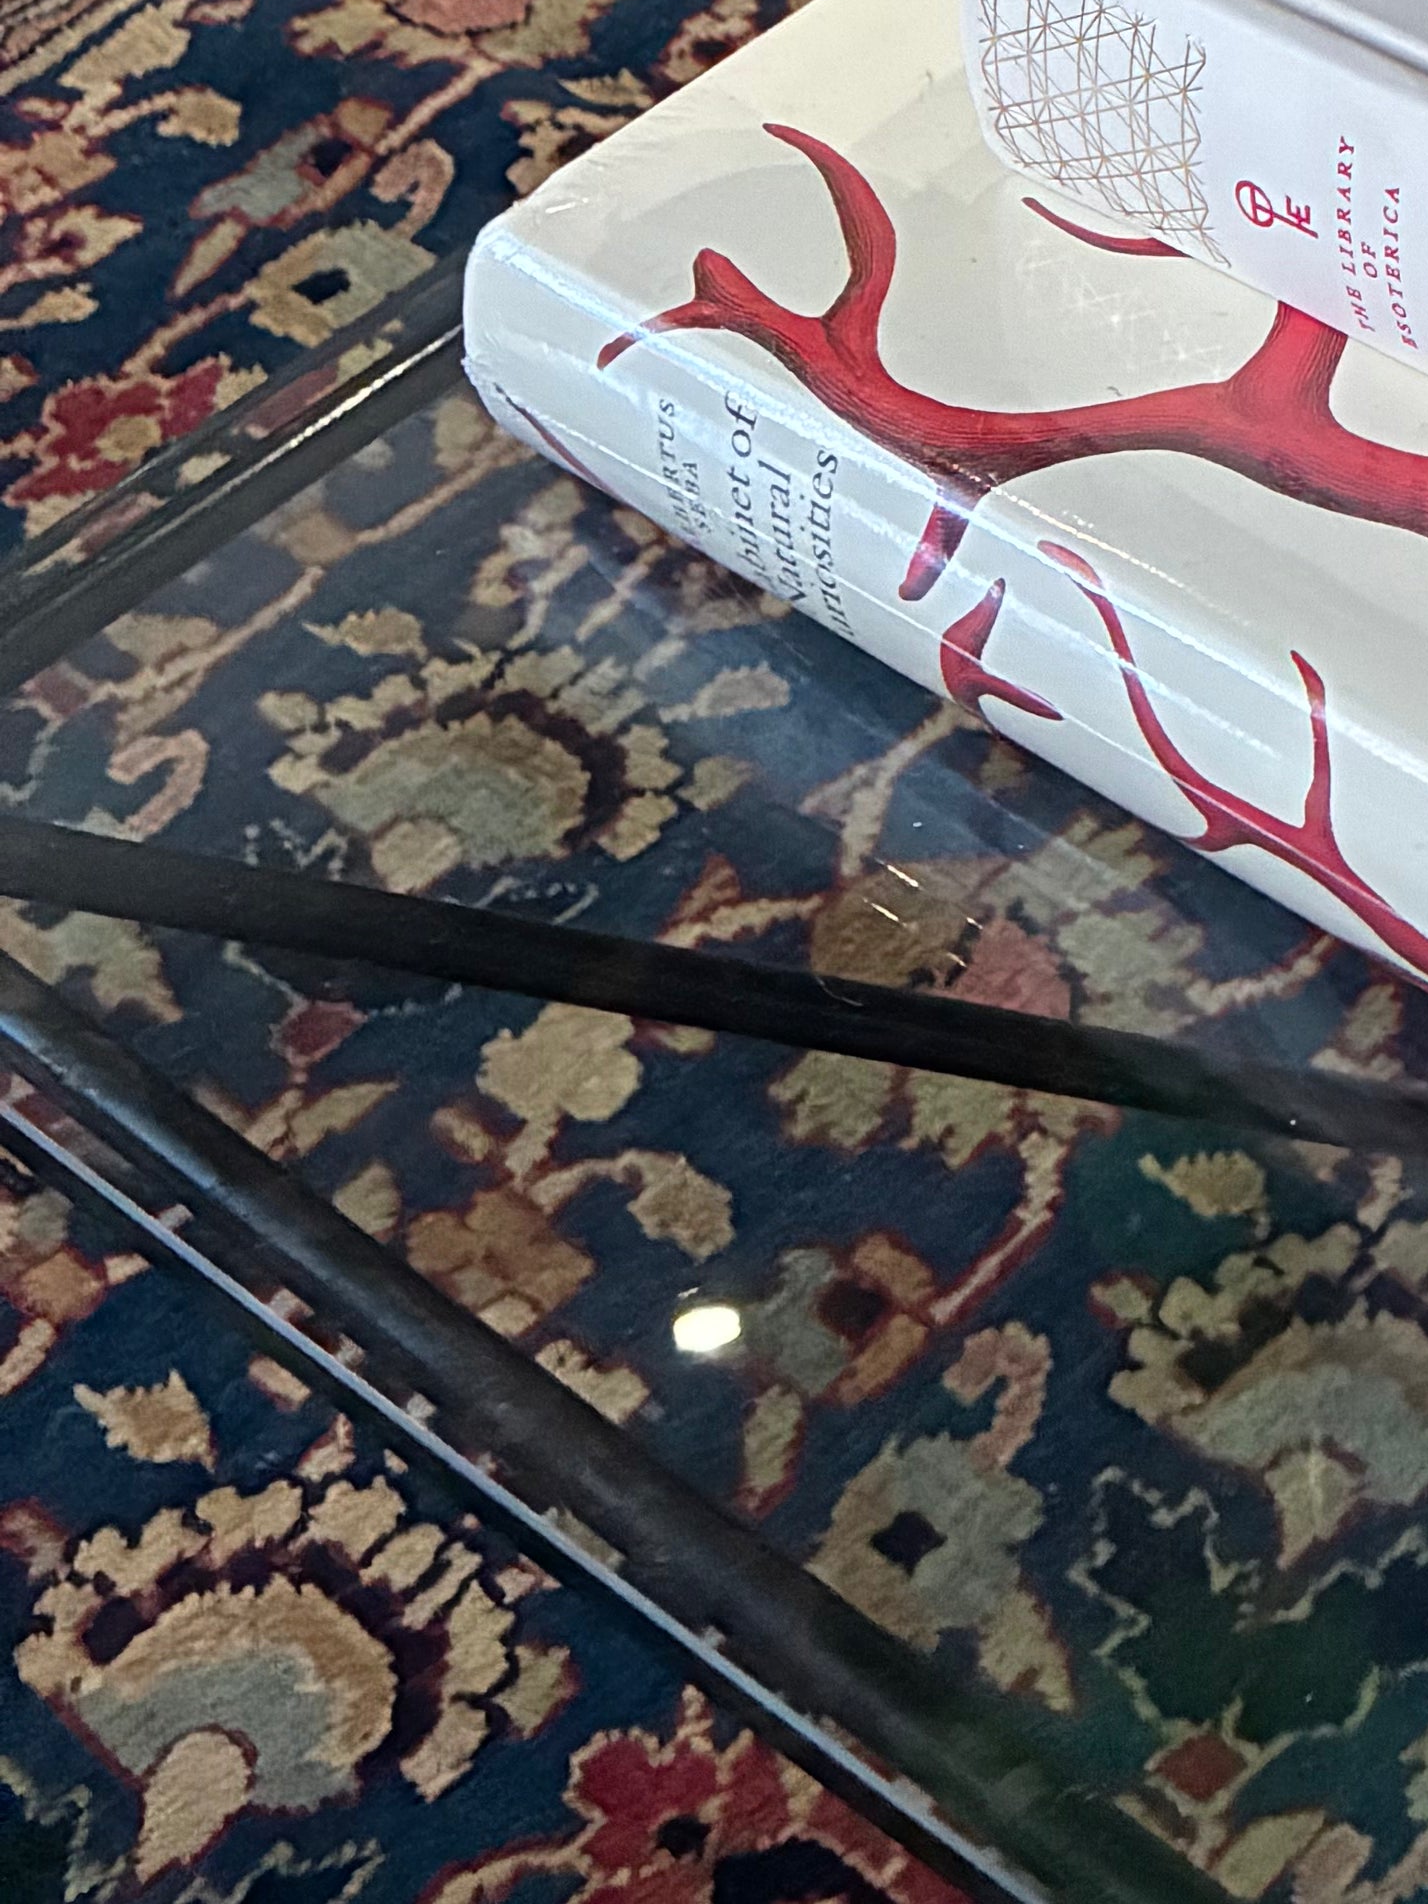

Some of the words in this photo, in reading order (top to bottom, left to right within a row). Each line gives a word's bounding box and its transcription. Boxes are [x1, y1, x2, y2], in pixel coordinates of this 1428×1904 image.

[1336, 135, 1355, 276] LIBRARY
[1360, 241, 1378, 279] OF
[1382, 187, 1418, 350] ESOTERICA
[1345, 285, 1376, 333] THE
[724, 390, 758, 458] of
